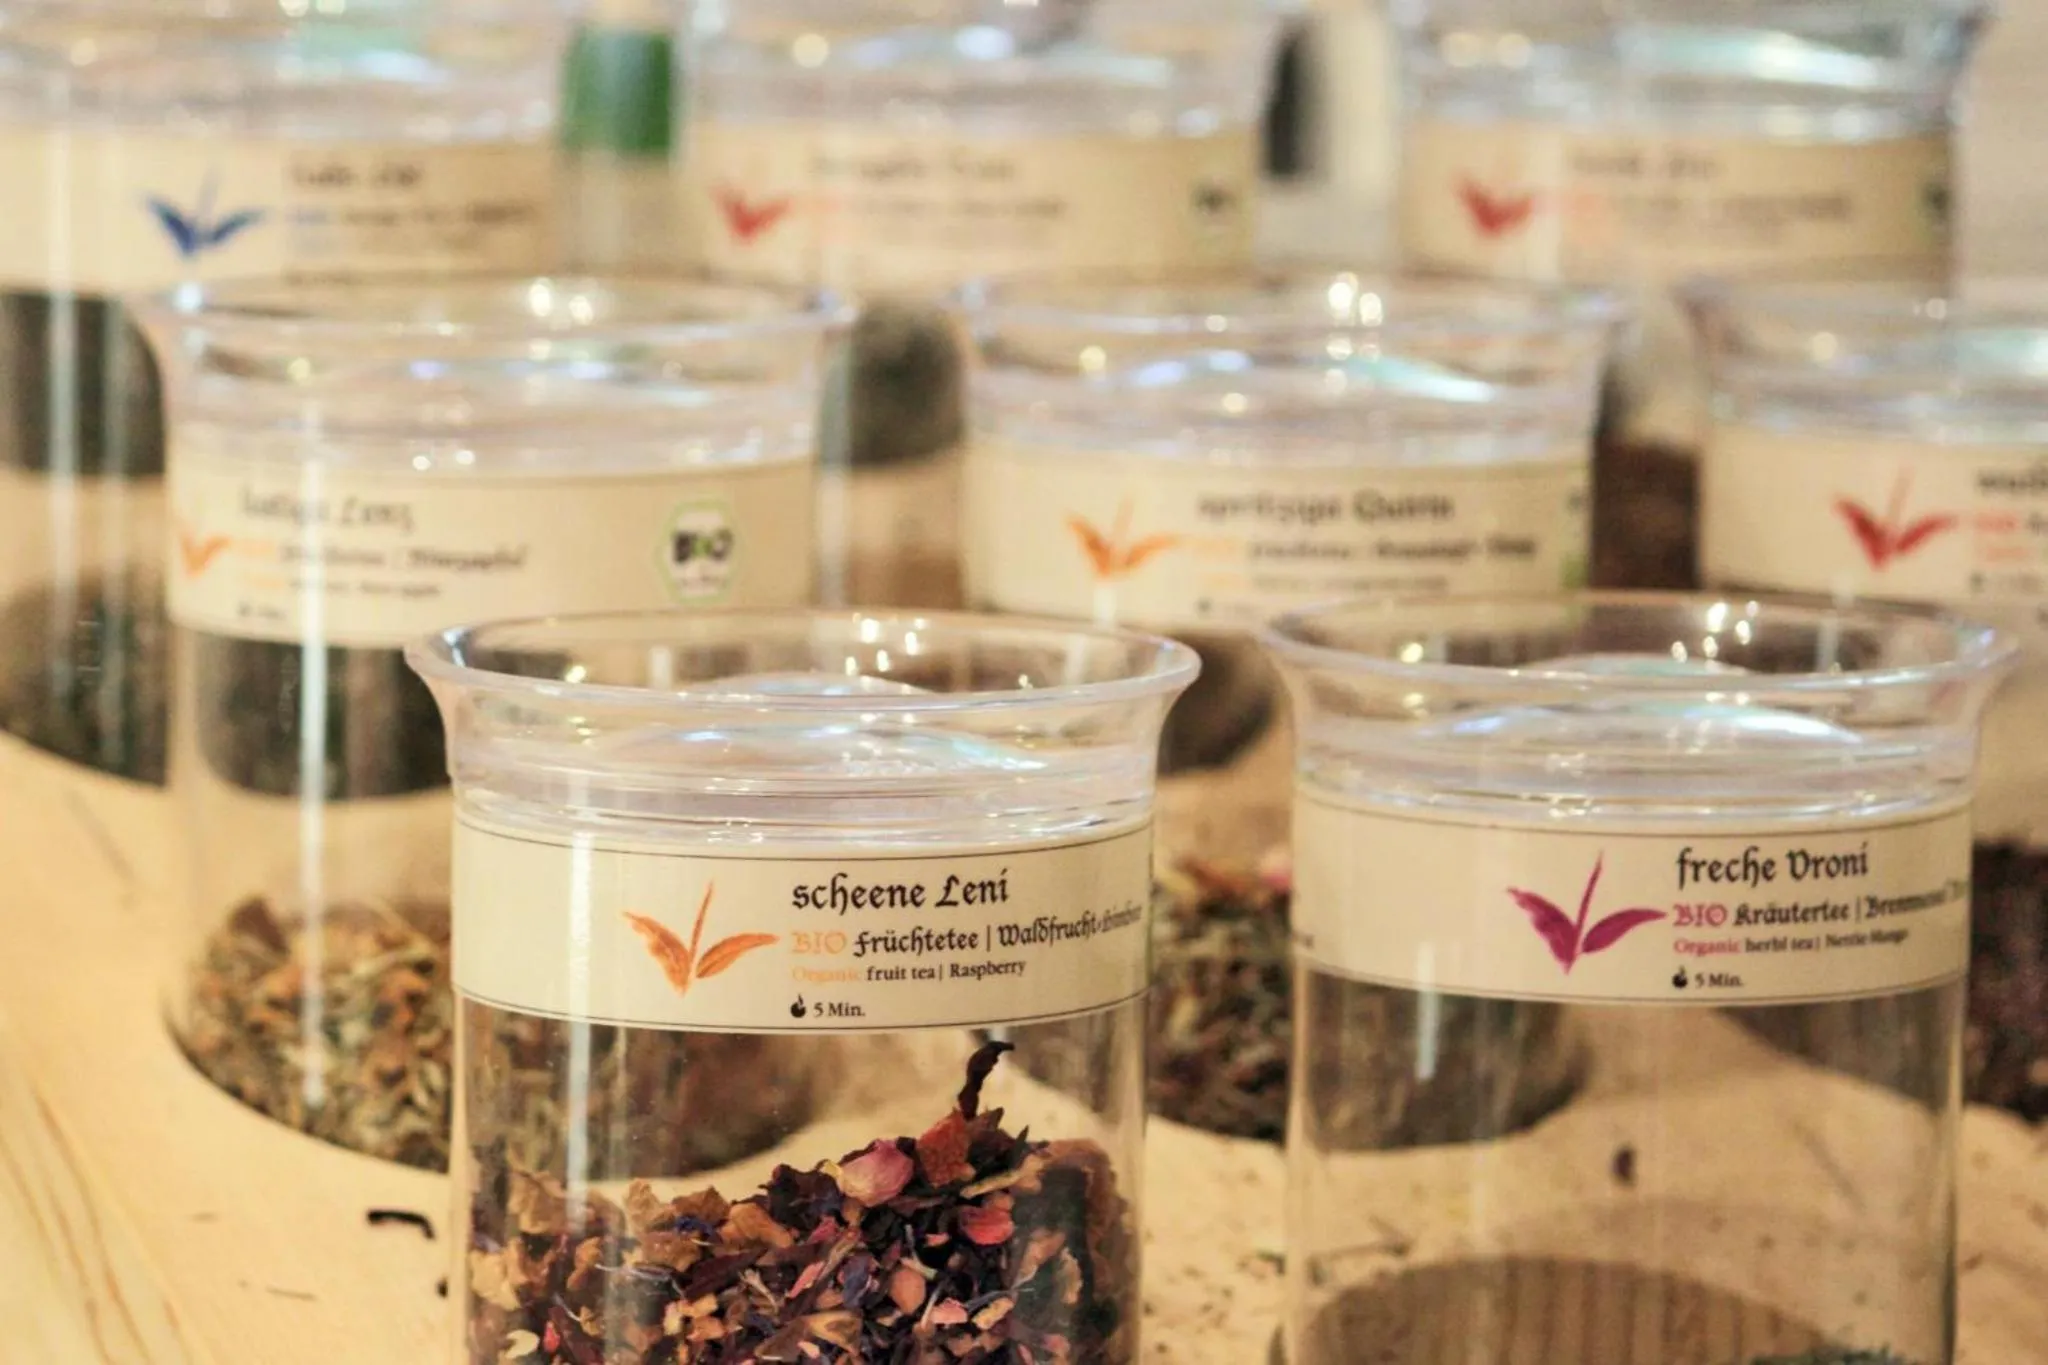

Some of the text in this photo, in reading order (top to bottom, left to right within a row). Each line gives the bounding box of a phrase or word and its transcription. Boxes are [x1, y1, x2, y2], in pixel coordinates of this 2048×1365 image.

[1676, 842, 1868, 889] freche Vroni
[792, 868, 1009, 916] scheene Leni
[1672, 903, 1728, 927] BIO
[1733, 900, 1850, 926] Kräutertee
[791, 930, 847, 954] BIO
[853, 926, 978, 957] Früchtetee
[1674, 937, 1741, 957] Organic
[1791, 937, 1813, 951] tea
[792, 966, 859, 984] Organic
[867, 966, 905, 981] fruit
[911, 967, 935, 981] tea
[949, 960, 1026, 981] Raspberry
[1694, 972, 1743, 988] 5 Min.
[814, 1002, 866, 1017] 5 Min.
